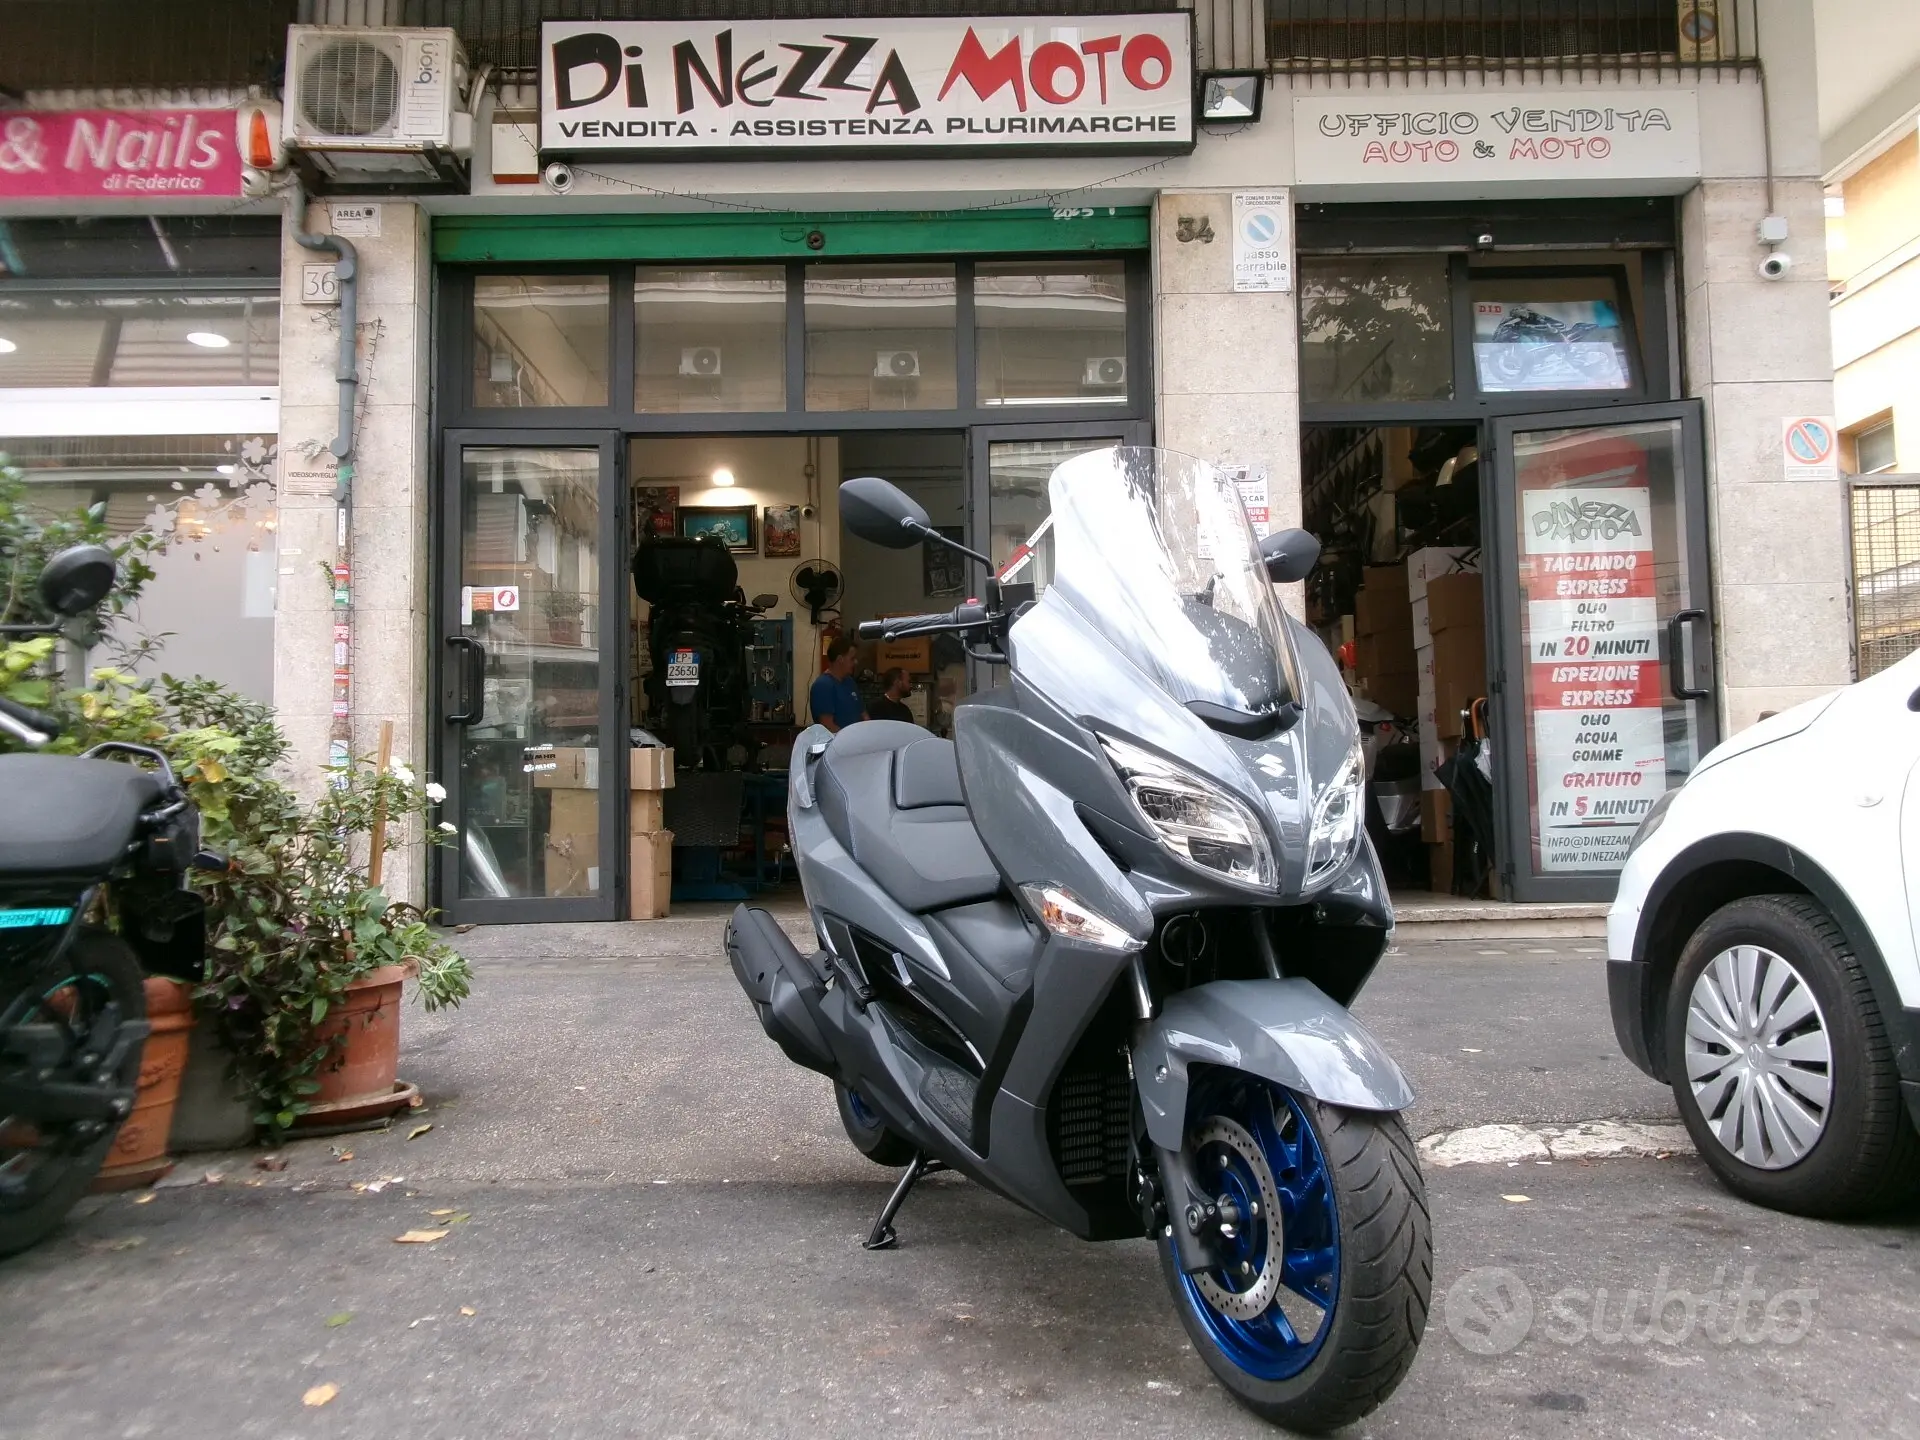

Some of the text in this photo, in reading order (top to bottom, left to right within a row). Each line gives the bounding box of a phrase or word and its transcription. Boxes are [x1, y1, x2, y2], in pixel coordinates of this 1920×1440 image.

[937, 25, 1172, 113] MOTO
[558, 120, 698, 138] VENDITA
[729, 117, 934, 137] ASSISTENZA
[946, 115, 1176, 134] PLURIMARCHE
[1319, 107, 1672, 137] UFFICIO VENDITA
[64, 113, 225, 171] Nails
[1363, 136, 1611, 163] AUTO & MOTO
[103, 173, 202, 191] di Federica
[337, 210, 361, 218] AREA
[1176, 216, 1216, 244] 34
[1244, 251, 1279, 263] passo
[1235, 262, 1287, 271] carrabile
[305, 271, 336, 296] 36
[1550, 519, 1619, 544] MOTO
[1543, 554, 1637, 573] TAGLIANDO
[1556, 578, 1628, 596] EXPRESS
[1577, 602, 1607, 615] OLIO
[1571, 620, 1615, 632] FILTRO
[1540, 636, 1650, 657] IN 20 MINUTI
[668, 665, 698, 677] 23630
[1551, 664, 1641, 682] ISPEZIONE
[1561, 688, 1634, 706] EXPRESS
[1580, 714, 1611, 726] OLIO
[1574, 731, 1618, 745] ACQUA
[1572, 749, 1624, 762] GOMME
[1562, 771, 1642, 788] GRATUITO
[1549, 801, 1569, 816] IN
[1574, 796, 1588, 816] 5
